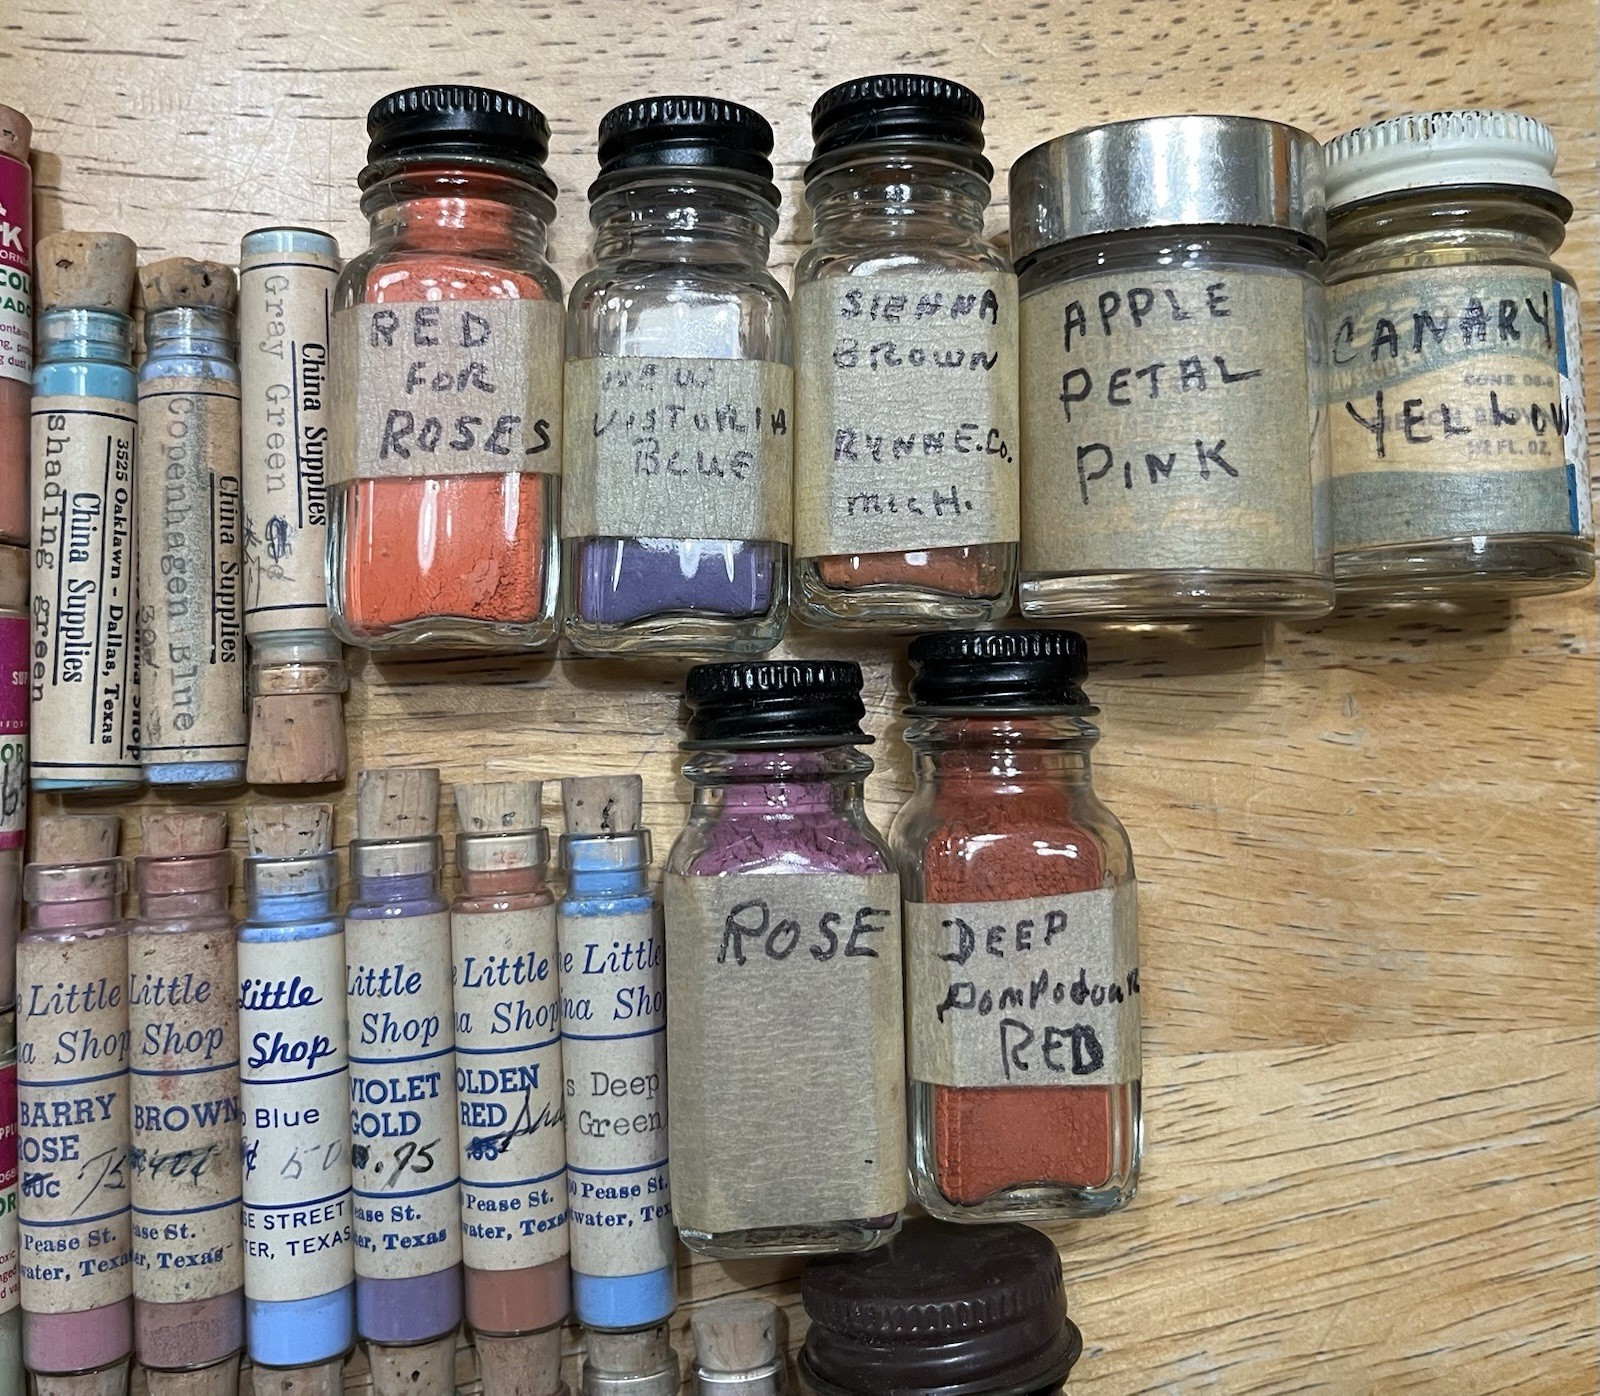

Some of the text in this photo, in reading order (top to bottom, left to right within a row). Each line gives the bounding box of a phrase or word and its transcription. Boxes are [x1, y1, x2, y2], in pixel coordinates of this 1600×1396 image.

[0, 269, 32, 300] COL
[370, 306, 492, 348] RED
[1064, 283, 1231, 353] APPLE
[1332, 291, 1553, 364] CANARY
[259, 276, 291, 494] Gray Green
[1059, 355, 1263, 423] PETAL
[301, 343, 328, 527] China Supplies
[379, 409, 551, 460] ROSES
[1345, 389, 1571, 459] YELLOW
[115, 438, 129, 482] 3525
[1077, 439, 1239, 505] PINK
[109, 487, 128, 579] Oaklawn
[32, 414, 71, 701] shading green
[159, 397, 199, 732] Copenhagen Blue
[215, 475, 241, 663] China Supplies
[60, 492, 101, 684] China Supplies
[102, 605, 124, 677] Dallas,
[101, 684, 120, 744] Texas
[717, 900, 891, 966] ROSE
[938, 910, 1068, 965] DEEP
[462, 951, 550, 988] Little
[581, 937, 661, 975] Little
[26, 977, 121, 1017] Little
[129, 972, 211, 1006] Little
[236, 976, 323, 1011] Little
[347, 964, 422, 998] Little
[54, 1028, 131, 1065] Shop
[142, 1022, 224, 1060] Shop
[360, 1011, 440, 1048] Shop
[1000, 1017, 1104, 1080] RED
[247, 1031, 338, 1070] Shop
[590, 1071, 661, 1100] Deep
[20, 1093, 116, 1128] BARRY
[134, 1096, 239, 1132] BROWN
[256, 1108, 320, 1129] Blue
[460, 1101, 508, 1128] RED
[579, 1109, 667, 1138] Green
[466, 1188, 555, 1213] Pease St.
[581, 1182, 641, 1200] Pease
[164, 1223, 197, 1241] St.
[263, 1201, 346, 1231] STREET
[391, 1204, 422, 1223] St.
[25, 1228, 117, 1252] Pease St.
[157, 1247, 224, 1269] Texas
[285, 1225, 350, 1257] TEXAS
[383, 1228, 447, 1251] Texas
